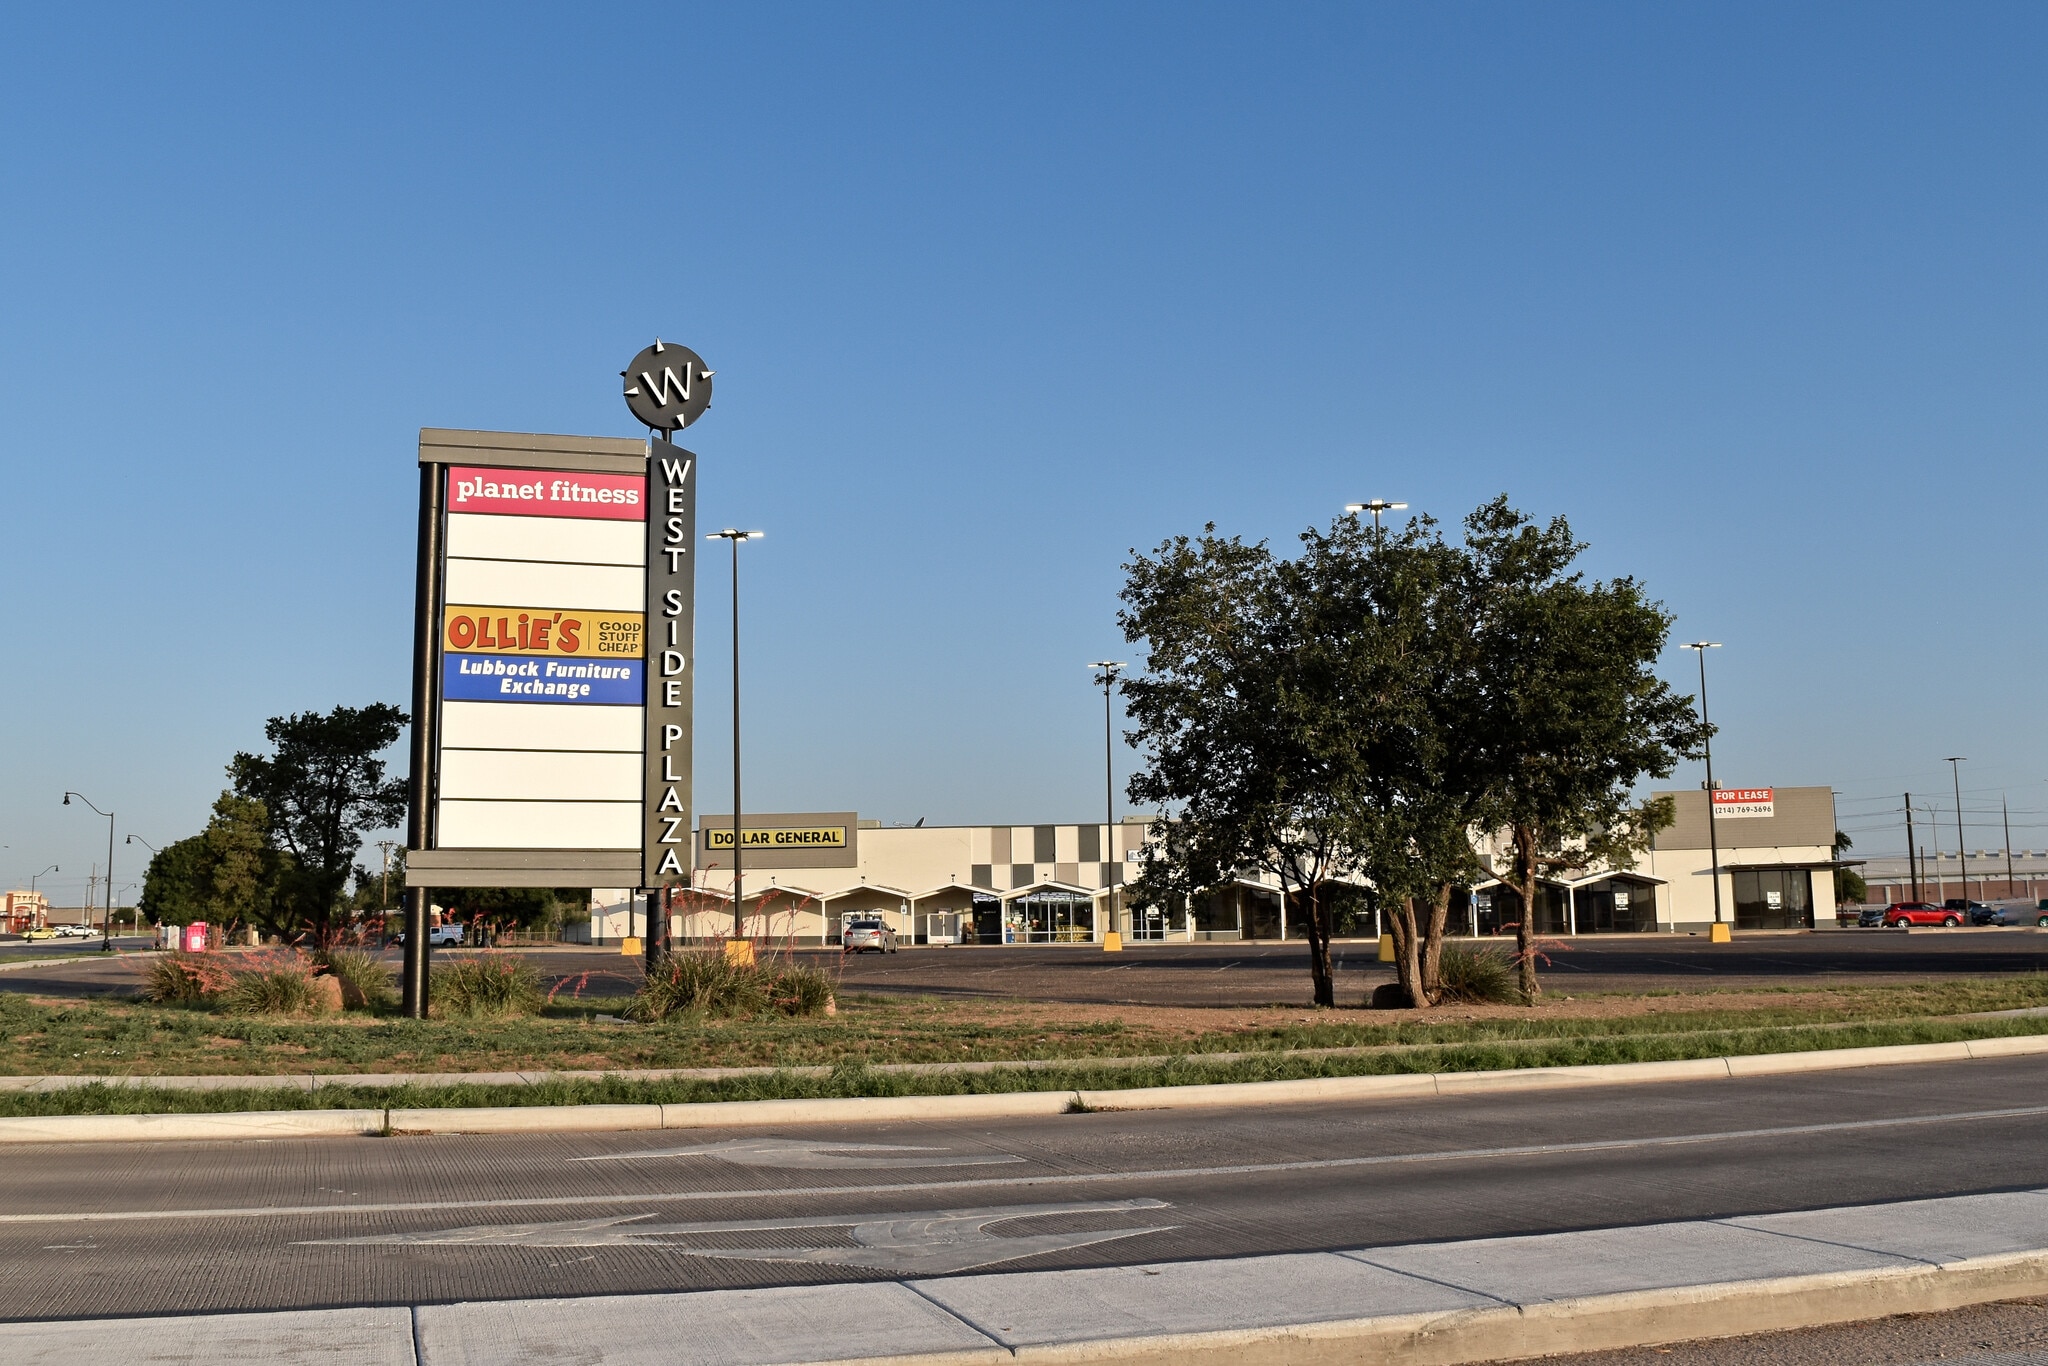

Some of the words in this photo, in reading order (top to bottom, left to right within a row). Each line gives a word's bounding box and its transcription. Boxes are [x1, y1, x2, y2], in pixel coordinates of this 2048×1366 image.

[641, 361, 692, 406] W
[456, 476, 544, 503] planet
[550, 480, 639, 505] fitness
[661, 458, 692, 573] WEST
[598, 631, 640, 642] STUFF
[664, 589, 686, 707] SIDE
[459, 659, 539, 677] Lubbock
[545, 662, 631, 680] Furniture
[500, 678, 591, 699] Exchange
[659, 723, 685, 875] PLAZA
[1715, 791, 1736, 800] FOR
[1738, 790, 1769, 800] LEASE
[1715, 806, 1735, 815] (214)
[1736, 805, 1772, 814] 769-3696
[714, 832, 770, 845] DOLAR
[775, 831, 840, 844] GENERAL
